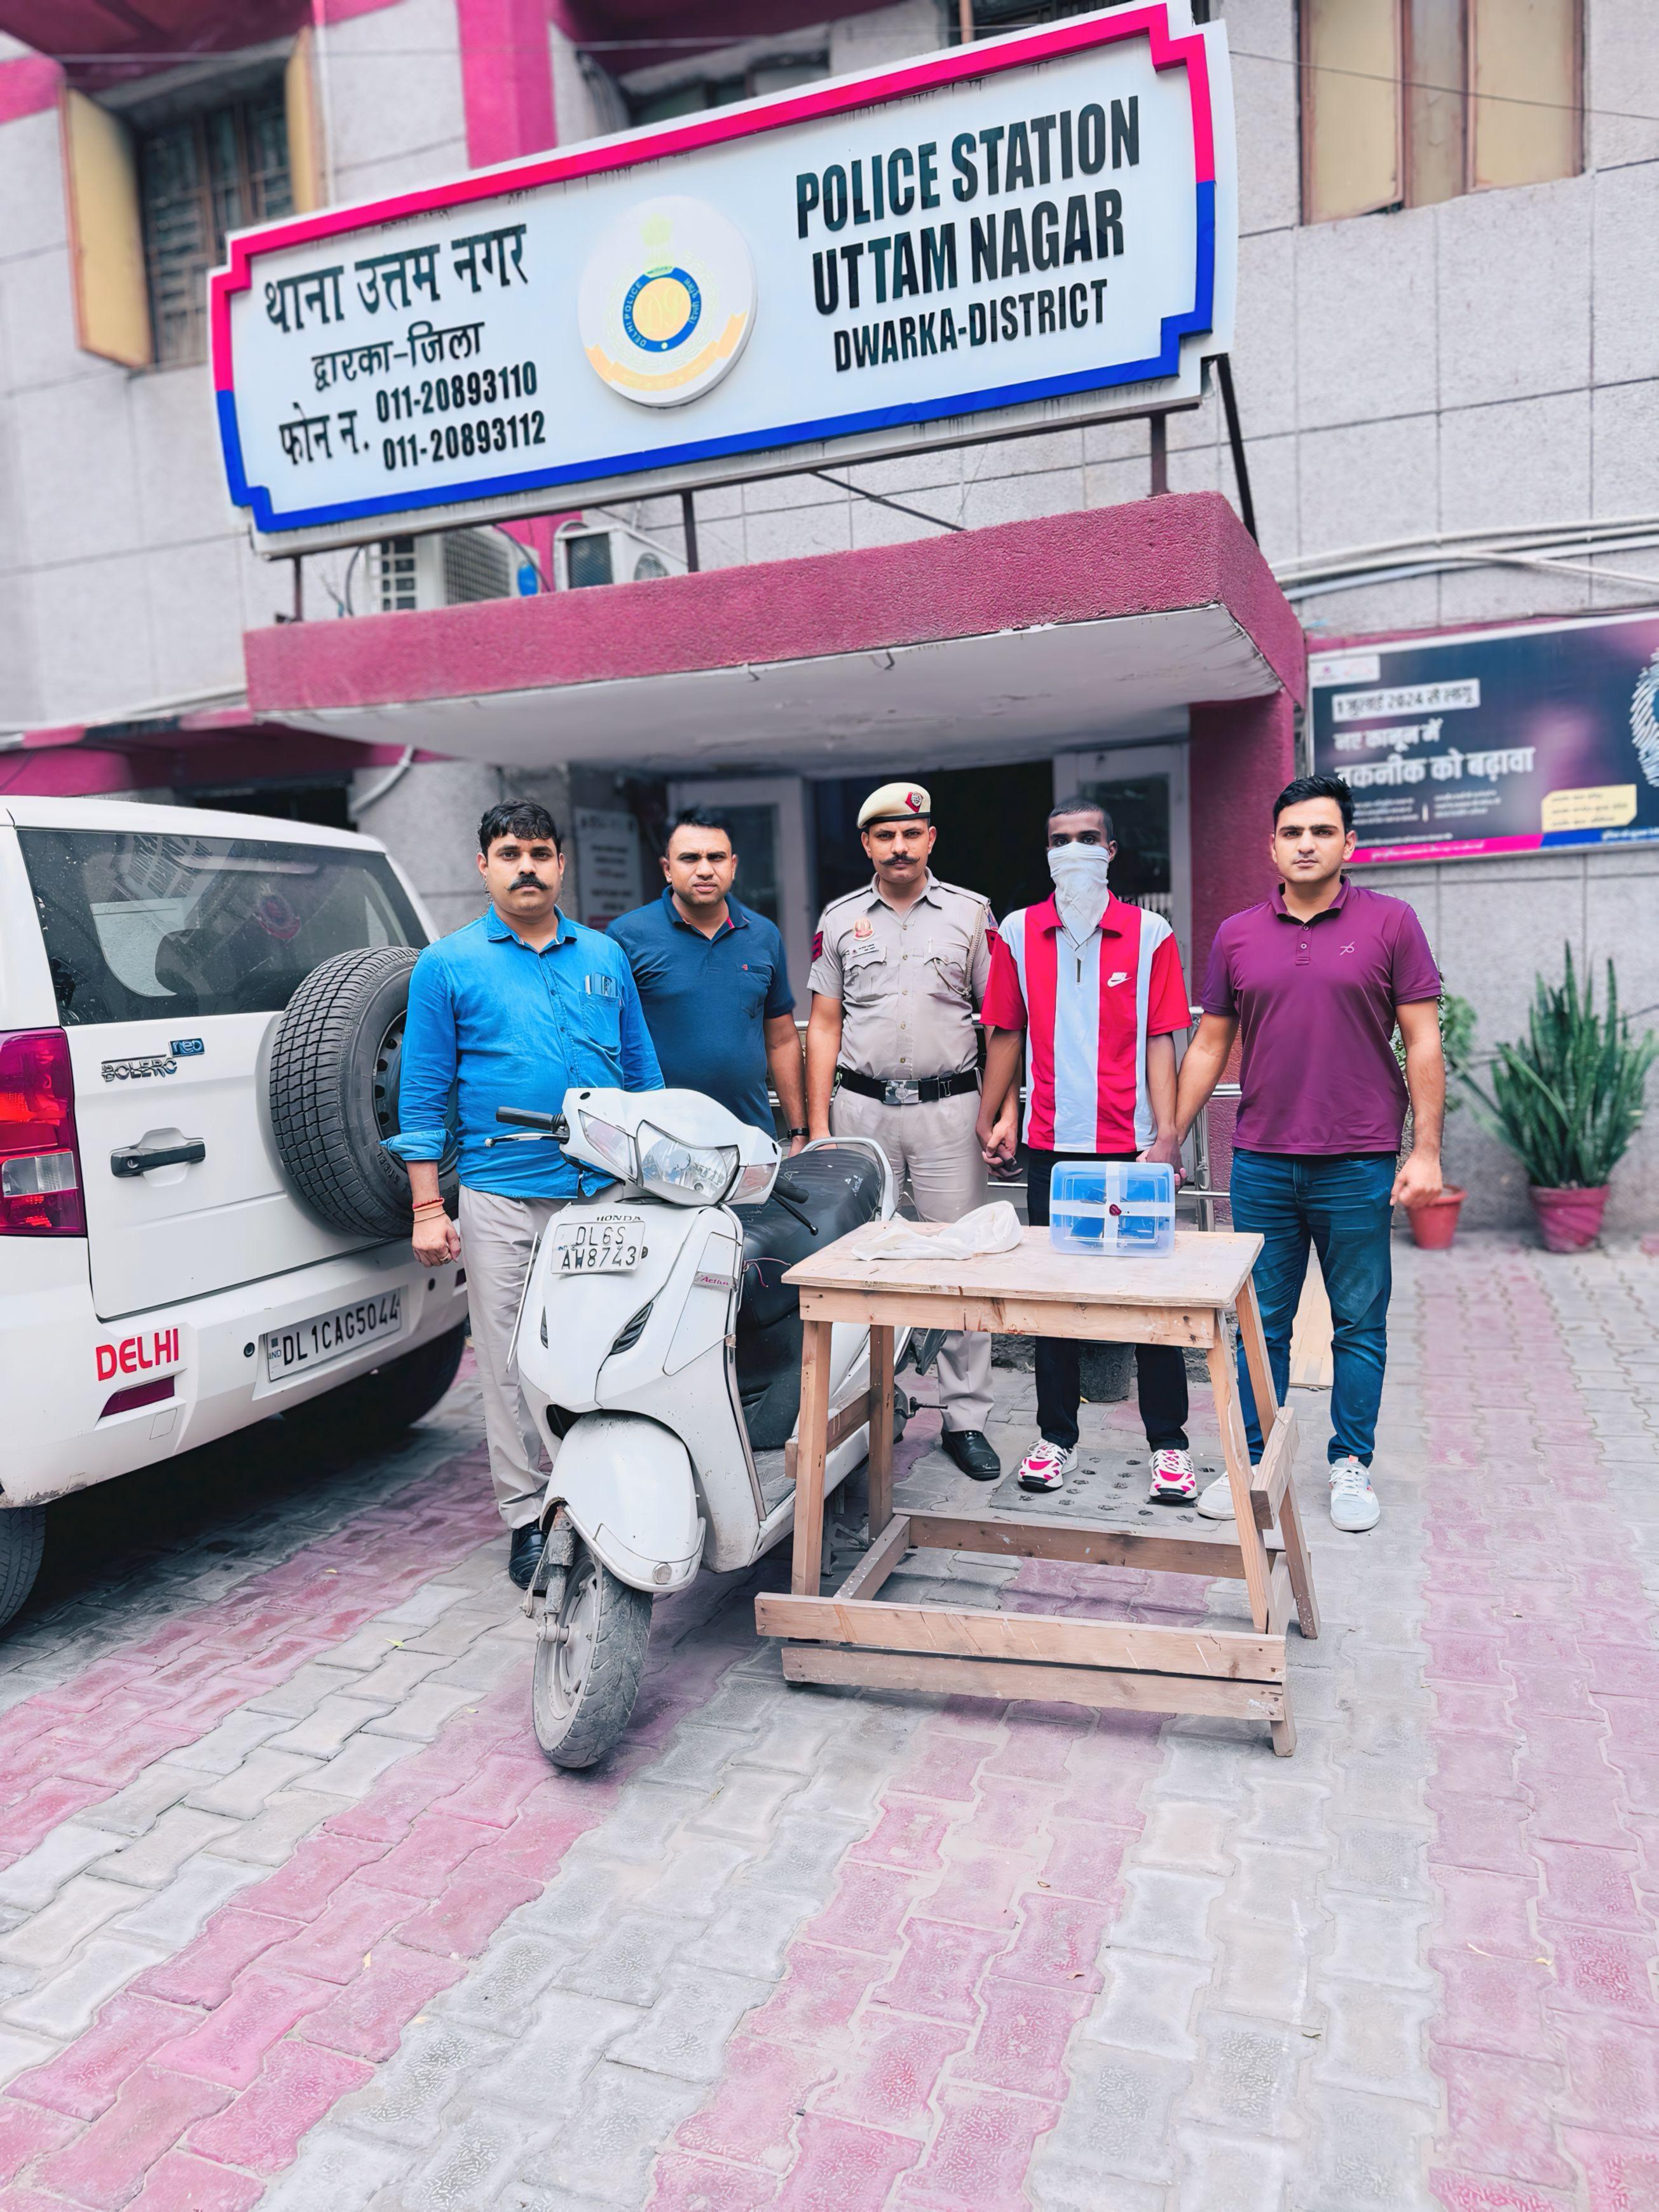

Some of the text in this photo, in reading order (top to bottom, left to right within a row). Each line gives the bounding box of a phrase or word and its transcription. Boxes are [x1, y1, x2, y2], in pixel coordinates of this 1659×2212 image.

[796, 95, 1140, 239] POLICE STATION
[264, 223, 529, 333] थाना उत्तम नगर
[812, 188, 1125, 317] UTTAM NAGAR
[624, 281, 647, 347] DELHI POLICE
[833, 278, 1108, 372] DWARKA-DISTRICT
[376, 360, 538, 423] 011-20893110
[278, 402, 332, 465] फोन
[382, 409, 546, 471] 011-20893112
[1387, 692, 1423, 709] 2024
[1428, 747, 1464, 781] को
[101, 1056, 178, 1082] BOLERO
[576, 1226, 626, 1246] DL6S
[95, 1328, 179, 1381] DELHI
